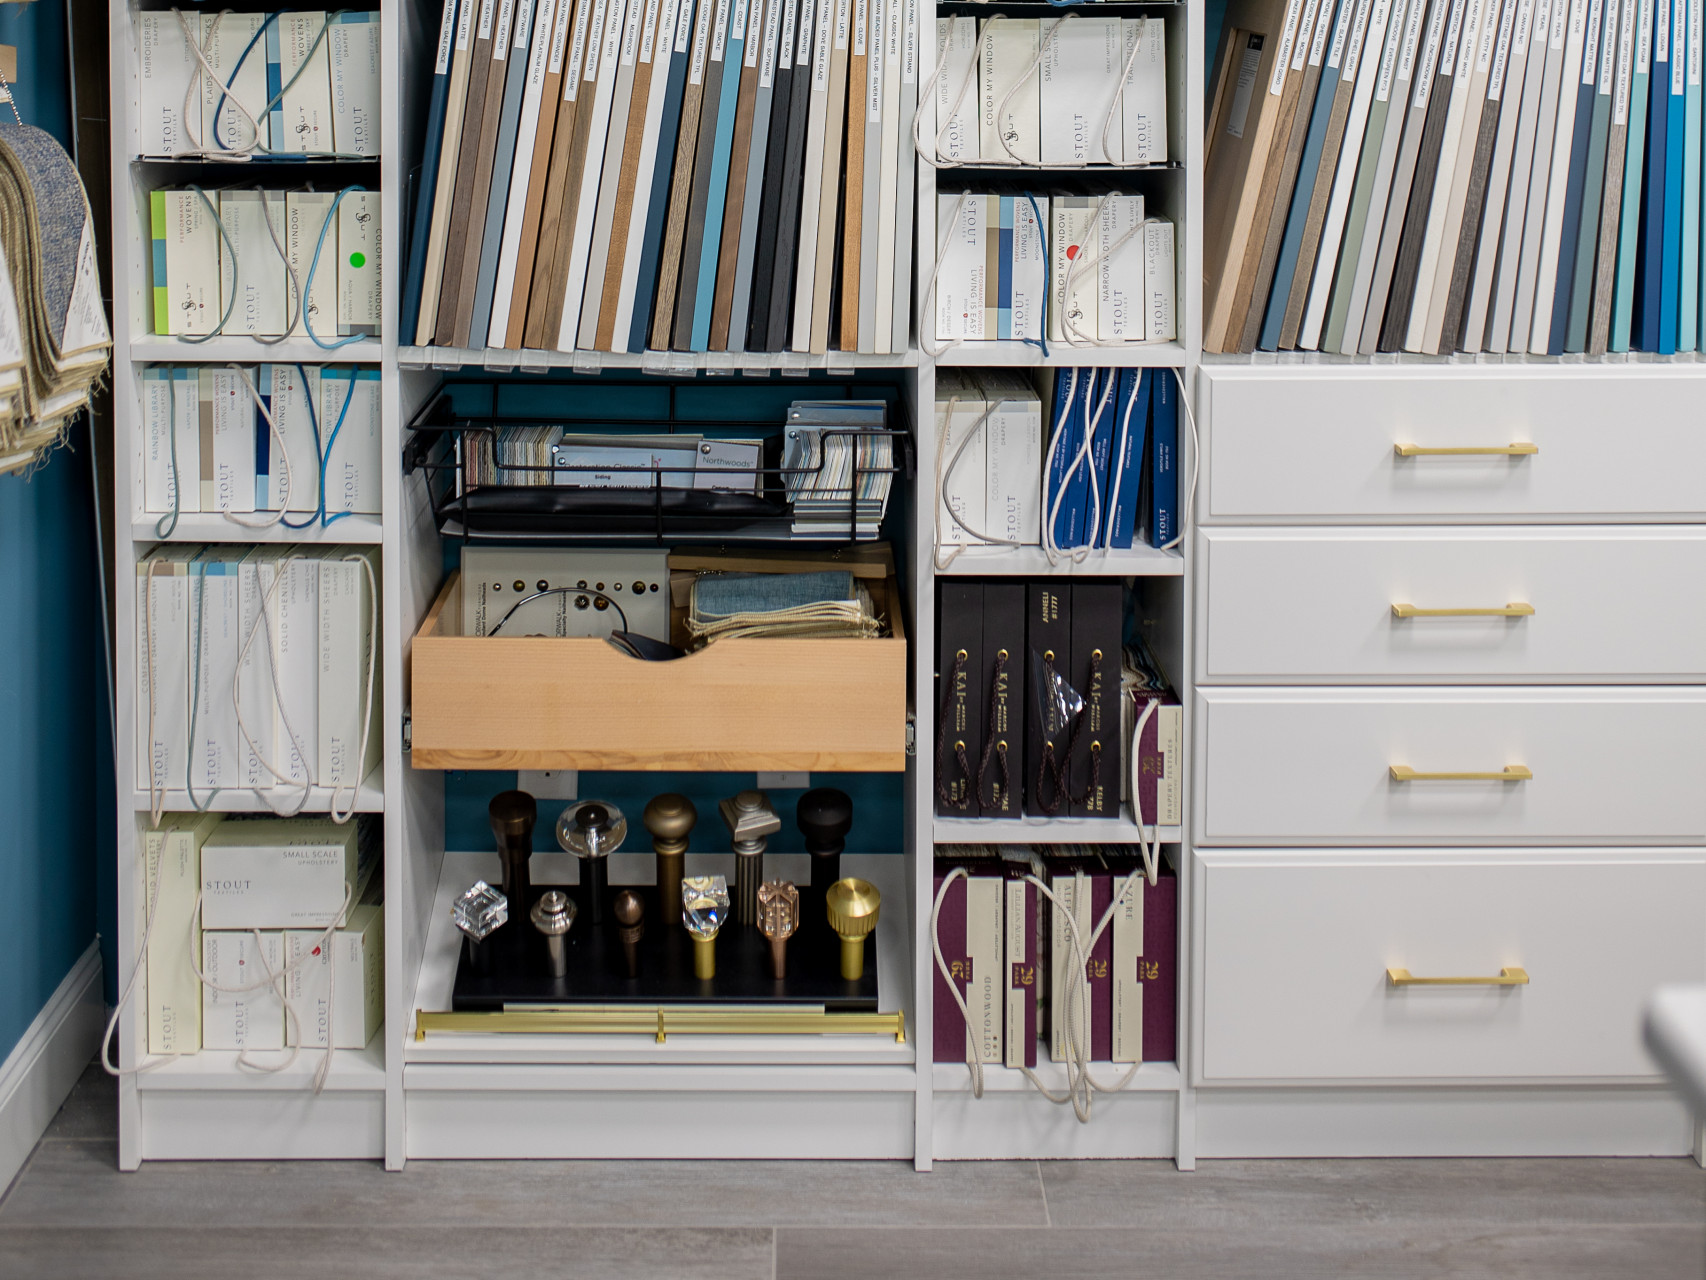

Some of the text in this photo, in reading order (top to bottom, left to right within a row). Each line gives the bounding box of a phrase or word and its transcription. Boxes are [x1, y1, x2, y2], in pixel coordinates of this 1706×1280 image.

[445, 7, 453, 25] PANEL
[519, 8, 528, 38] SOFTWARE
[701, 4, 709, 22] LODGE
[1451, 10, 1461, 35] VERTICAL
[592, 14, 602, 39] FEATHER
[1356, 16, 1364, 33] PANEL
[553, 32, 563, 63] CORIANDER
[626, 24, 635, 56] MUSHROOM
[695, 36, 704, 64] TEXTURED
[1351, 39, 1359, 56] SHELL
[588, 53, 596, 71] SHEEN
[1445, 40, 1454, 65] NATURAL
[334, 29, 345, 114] COLOR MY WINDOW
[1348, 56, 1356, 72] GRAY
[702, 456, 751, 468] Northwoods
[206, 880, 252, 889] STOUT
[951, 961, 964, 979] 29
[983, 976, 992, 1058] COTTONWOOD
